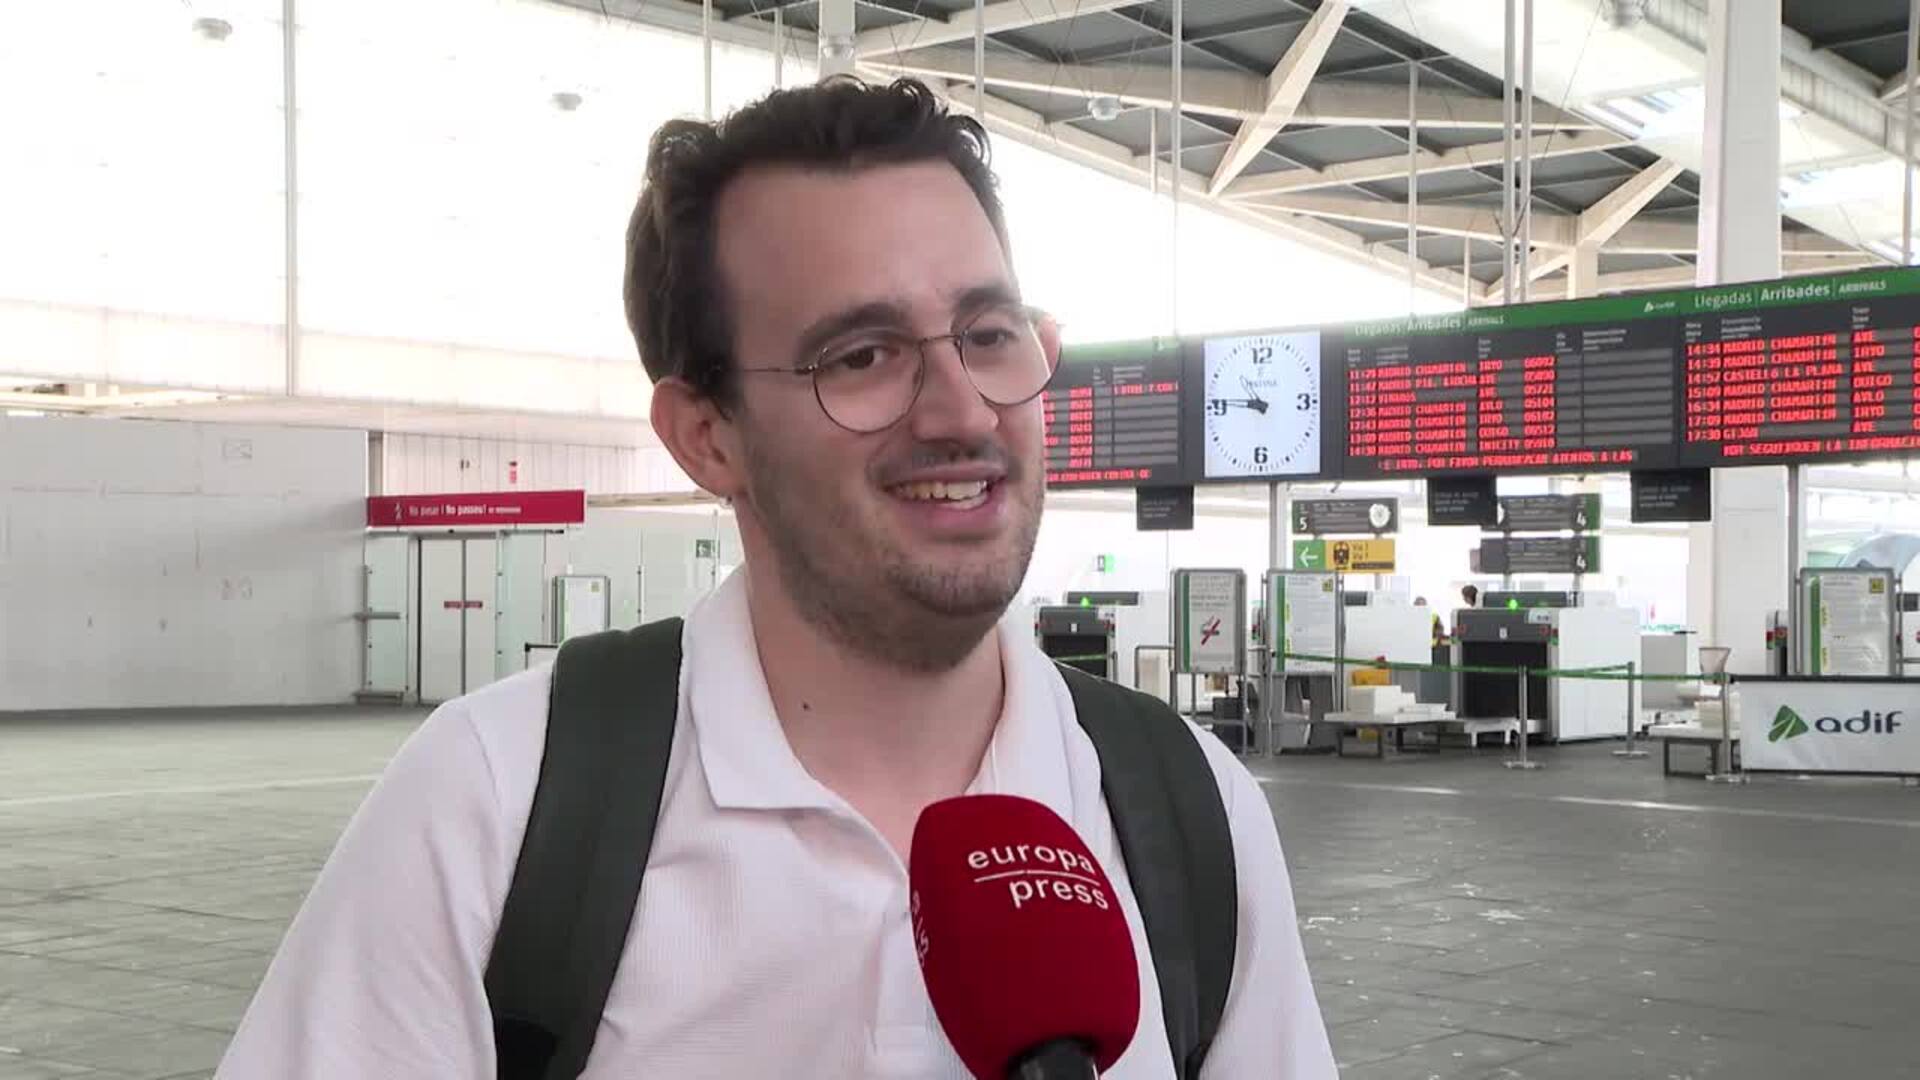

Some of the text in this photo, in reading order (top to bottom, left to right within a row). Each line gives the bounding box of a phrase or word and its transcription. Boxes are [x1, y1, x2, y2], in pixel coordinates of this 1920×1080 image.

[1694, 279, 1887, 310] Llegadas Arribades ARRIVALS
[1723, 340, 1765, 354] MADRID
[1771, 334, 1837, 349] CHAMARTIN
[1252, 347, 1272, 364] 12
[1723, 354, 1765, 368] MADRID
[1771, 349, 1837, 364] CHAMARTIN
[1723, 383, 1765, 397] MADRID
[1771, 379, 1837, 394] CHAMARTIN
[1212, 393, 1311, 416] 9 3
[1723, 398, 1765, 412] MADRID
[1771, 394, 1837, 409] CHAMARTIN
[1723, 412, 1765, 426] MADRID
[1771, 408, 1837, 423] CHAMARTIN
[1254, 446, 1268, 464] 6
[1300, 516, 1307, 530] 5
[1577, 511, 1586, 526] 4
[1577, 553, 1586, 569] 4
[1815, 710, 1903, 735] adif
[967, 845, 1096, 875] europa
[1009, 878, 1109, 909] press
